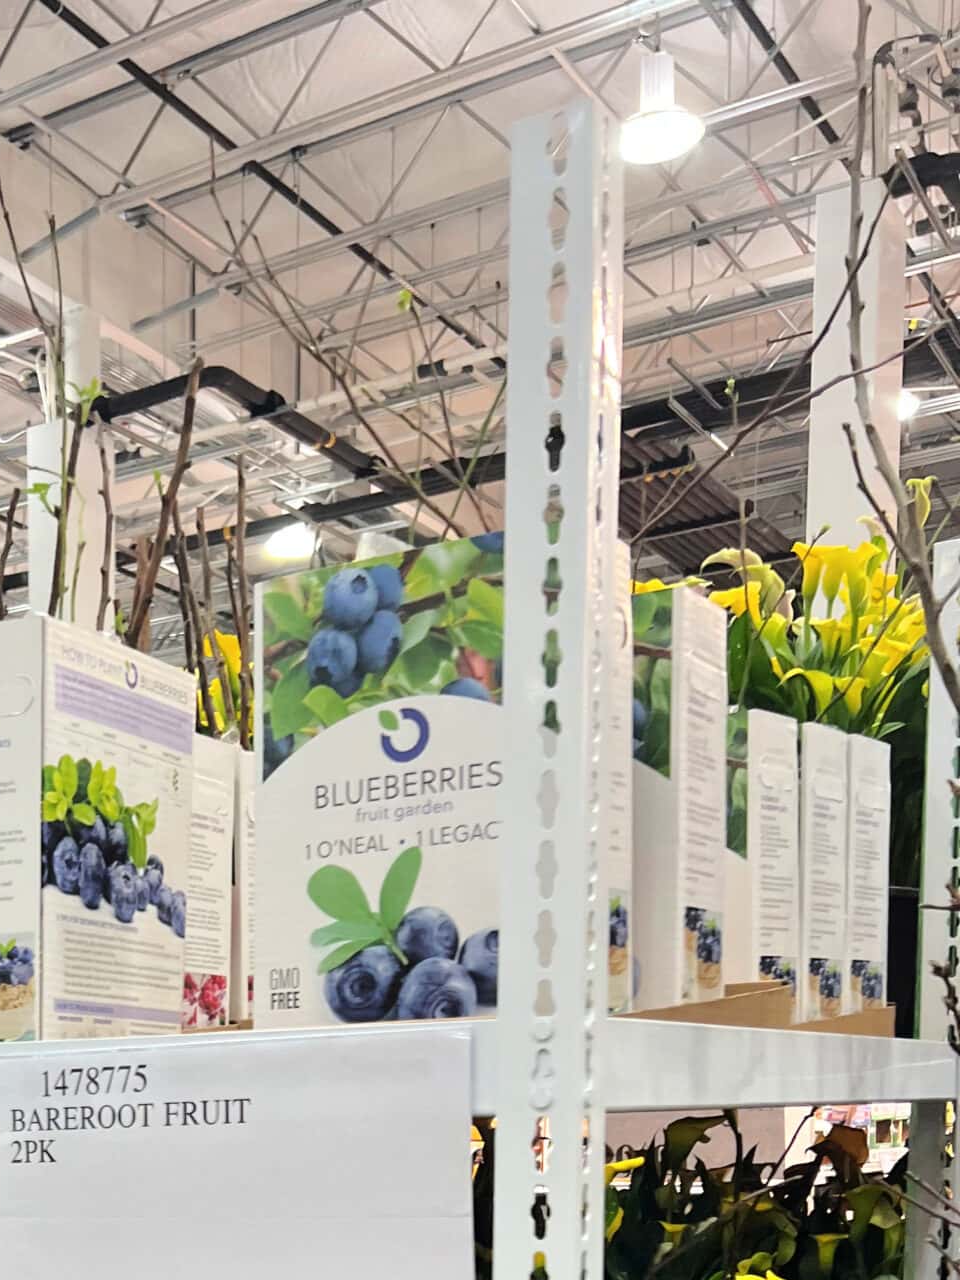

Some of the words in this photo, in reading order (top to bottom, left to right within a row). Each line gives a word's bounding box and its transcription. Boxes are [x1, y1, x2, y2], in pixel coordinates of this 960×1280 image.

[314, 761, 504, 810] BLUEBERRIES
[355, 806, 389, 823] fruit
[394, 800, 454, 822] garden
[305, 844, 311, 860] 1
[429, 820, 505, 847] LEGAC
[269, 967, 301, 990] GMO
[270, 992, 301, 1010] FREE
[42, 1064, 148, 1098] 1478775
[10, 1103, 154, 1133] BAREROOT
[163, 1098, 252, 1127] FRUIT
[10, 1139, 57, 1164] 2PK
